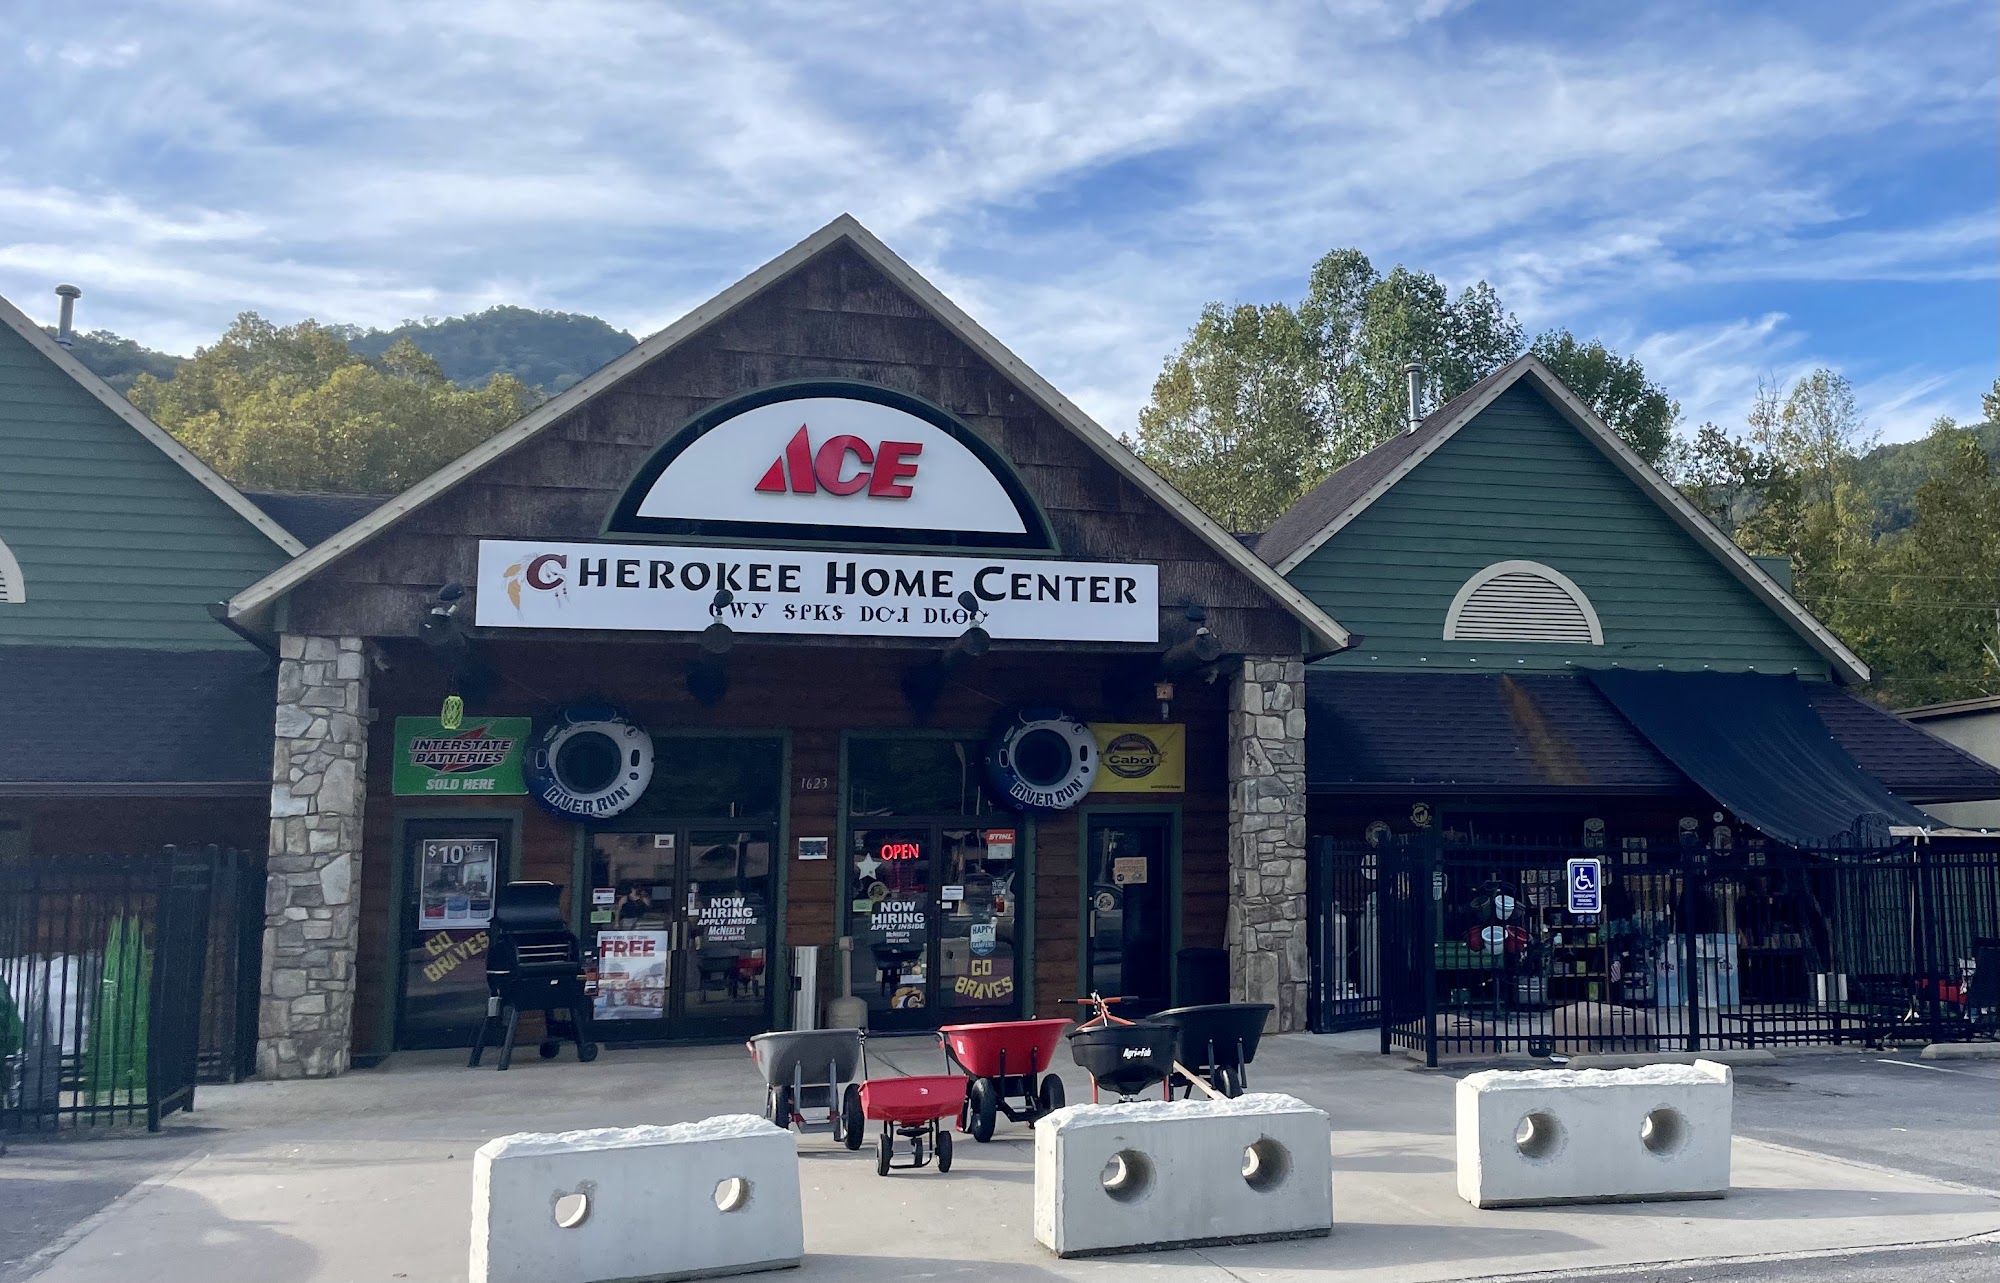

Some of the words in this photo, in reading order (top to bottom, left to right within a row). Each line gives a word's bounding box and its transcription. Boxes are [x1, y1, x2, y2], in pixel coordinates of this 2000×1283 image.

[755, 423, 923, 498] ACE
[526, 554, 802, 595] CHEROKEE
[825, 561, 954, 598] HOME
[973, 565, 1138, 605] CENTER
[411, 738, 513, 752] INTERSTATE
[413, 751, 507, 765] BATTERIES
[1109, 755, 1155, 765] Cabot
[425, 778, 460, 791] SOLD
[463, 778, 496, 790] HERE
[801, 777, 828, 790] 1623
[543, 786, 594, 814] RIVER
[596, 783, 631, 812] RUN
[1010, 781, 1055, 807] RIVER
[1056, 778, 1085, 803] RUN
[989, 832, 1013, 842] STIHL
[428, 843, 464, 865] $10
[464, 844, 484, 854] OFF
[881, 843, 920, 861] OPEN
[711, 897, 745, 908] NOW
[880, 901, 916, 913] NOW
[702, 908, 753, 918] HIRING
[871, 913, 924, 924] HIRING
[697, 918, 726, 926] APPLY
[727, 917, 758, 926] INSIDE
[870, 923, 897, 931] APPLY
[897, 922, 926, 931] INSIDE
[425, 931, 454, 957] GO
[601, 940, 656, 958] FREE
[424, 931, 490, 983] BRAVES
[971, 959, 992, 976] GO
[954, 975, 1013, 1000] BRAVES
